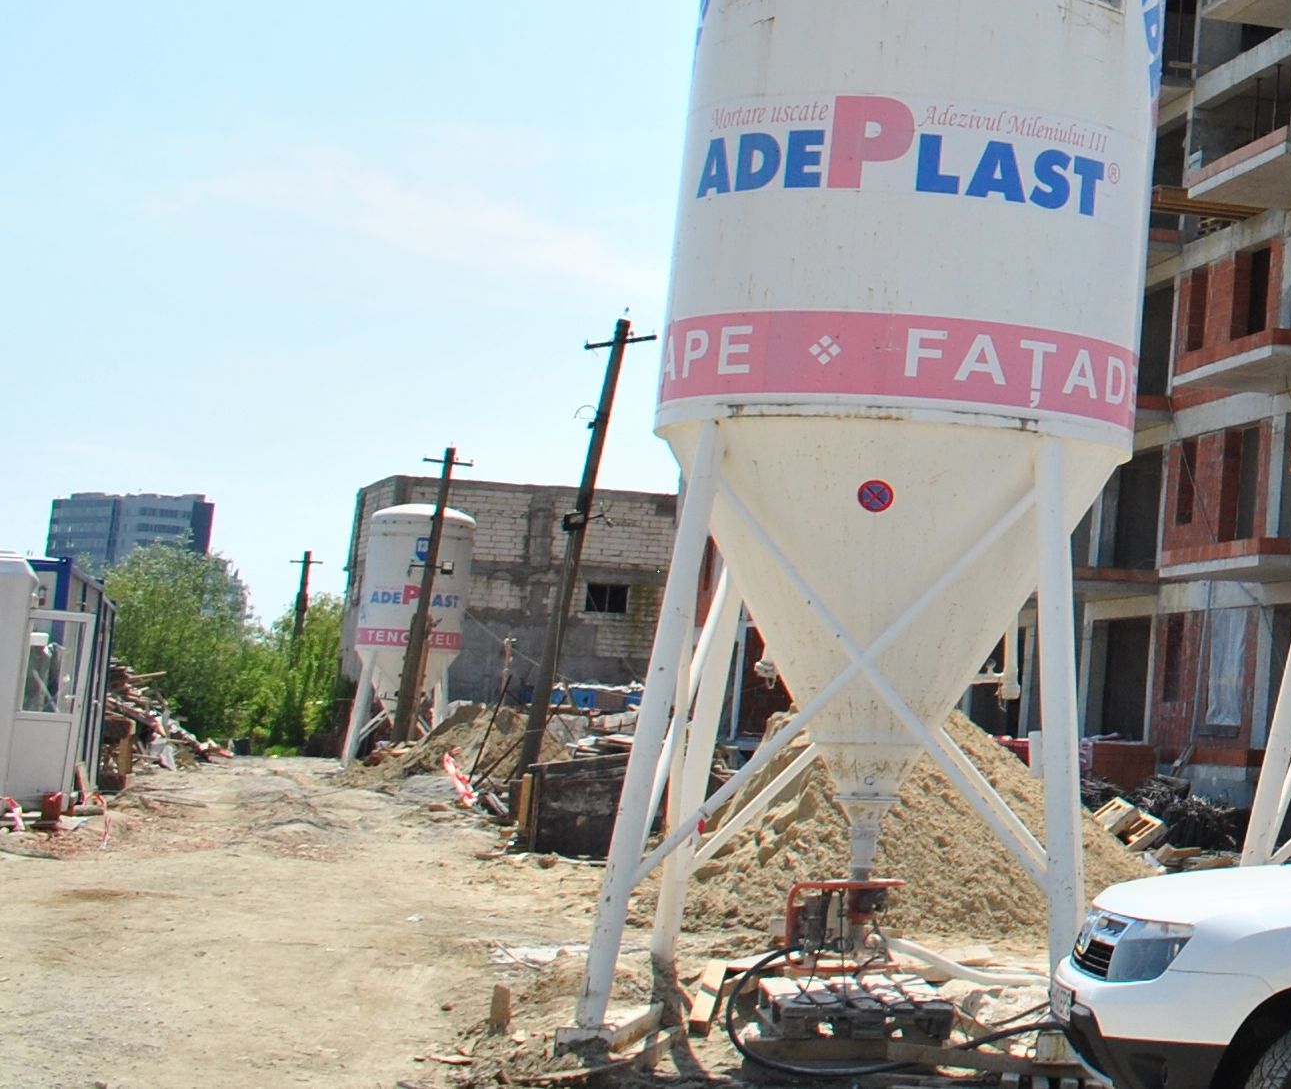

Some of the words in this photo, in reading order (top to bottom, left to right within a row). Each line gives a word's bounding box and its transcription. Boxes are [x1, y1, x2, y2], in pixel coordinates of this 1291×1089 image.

[710, 107, 767, 131] Mortare
[770, 101, 829, 123] uscate
[918, 104, 1007, 132] Adezivul
[1006, 114, 1086, 147] Mileniului
[1087, 131, 1108, 154] III
[696, 95, 1105, 217] ADEPLAST
[370, 585, 460, 608] ADEPAST
